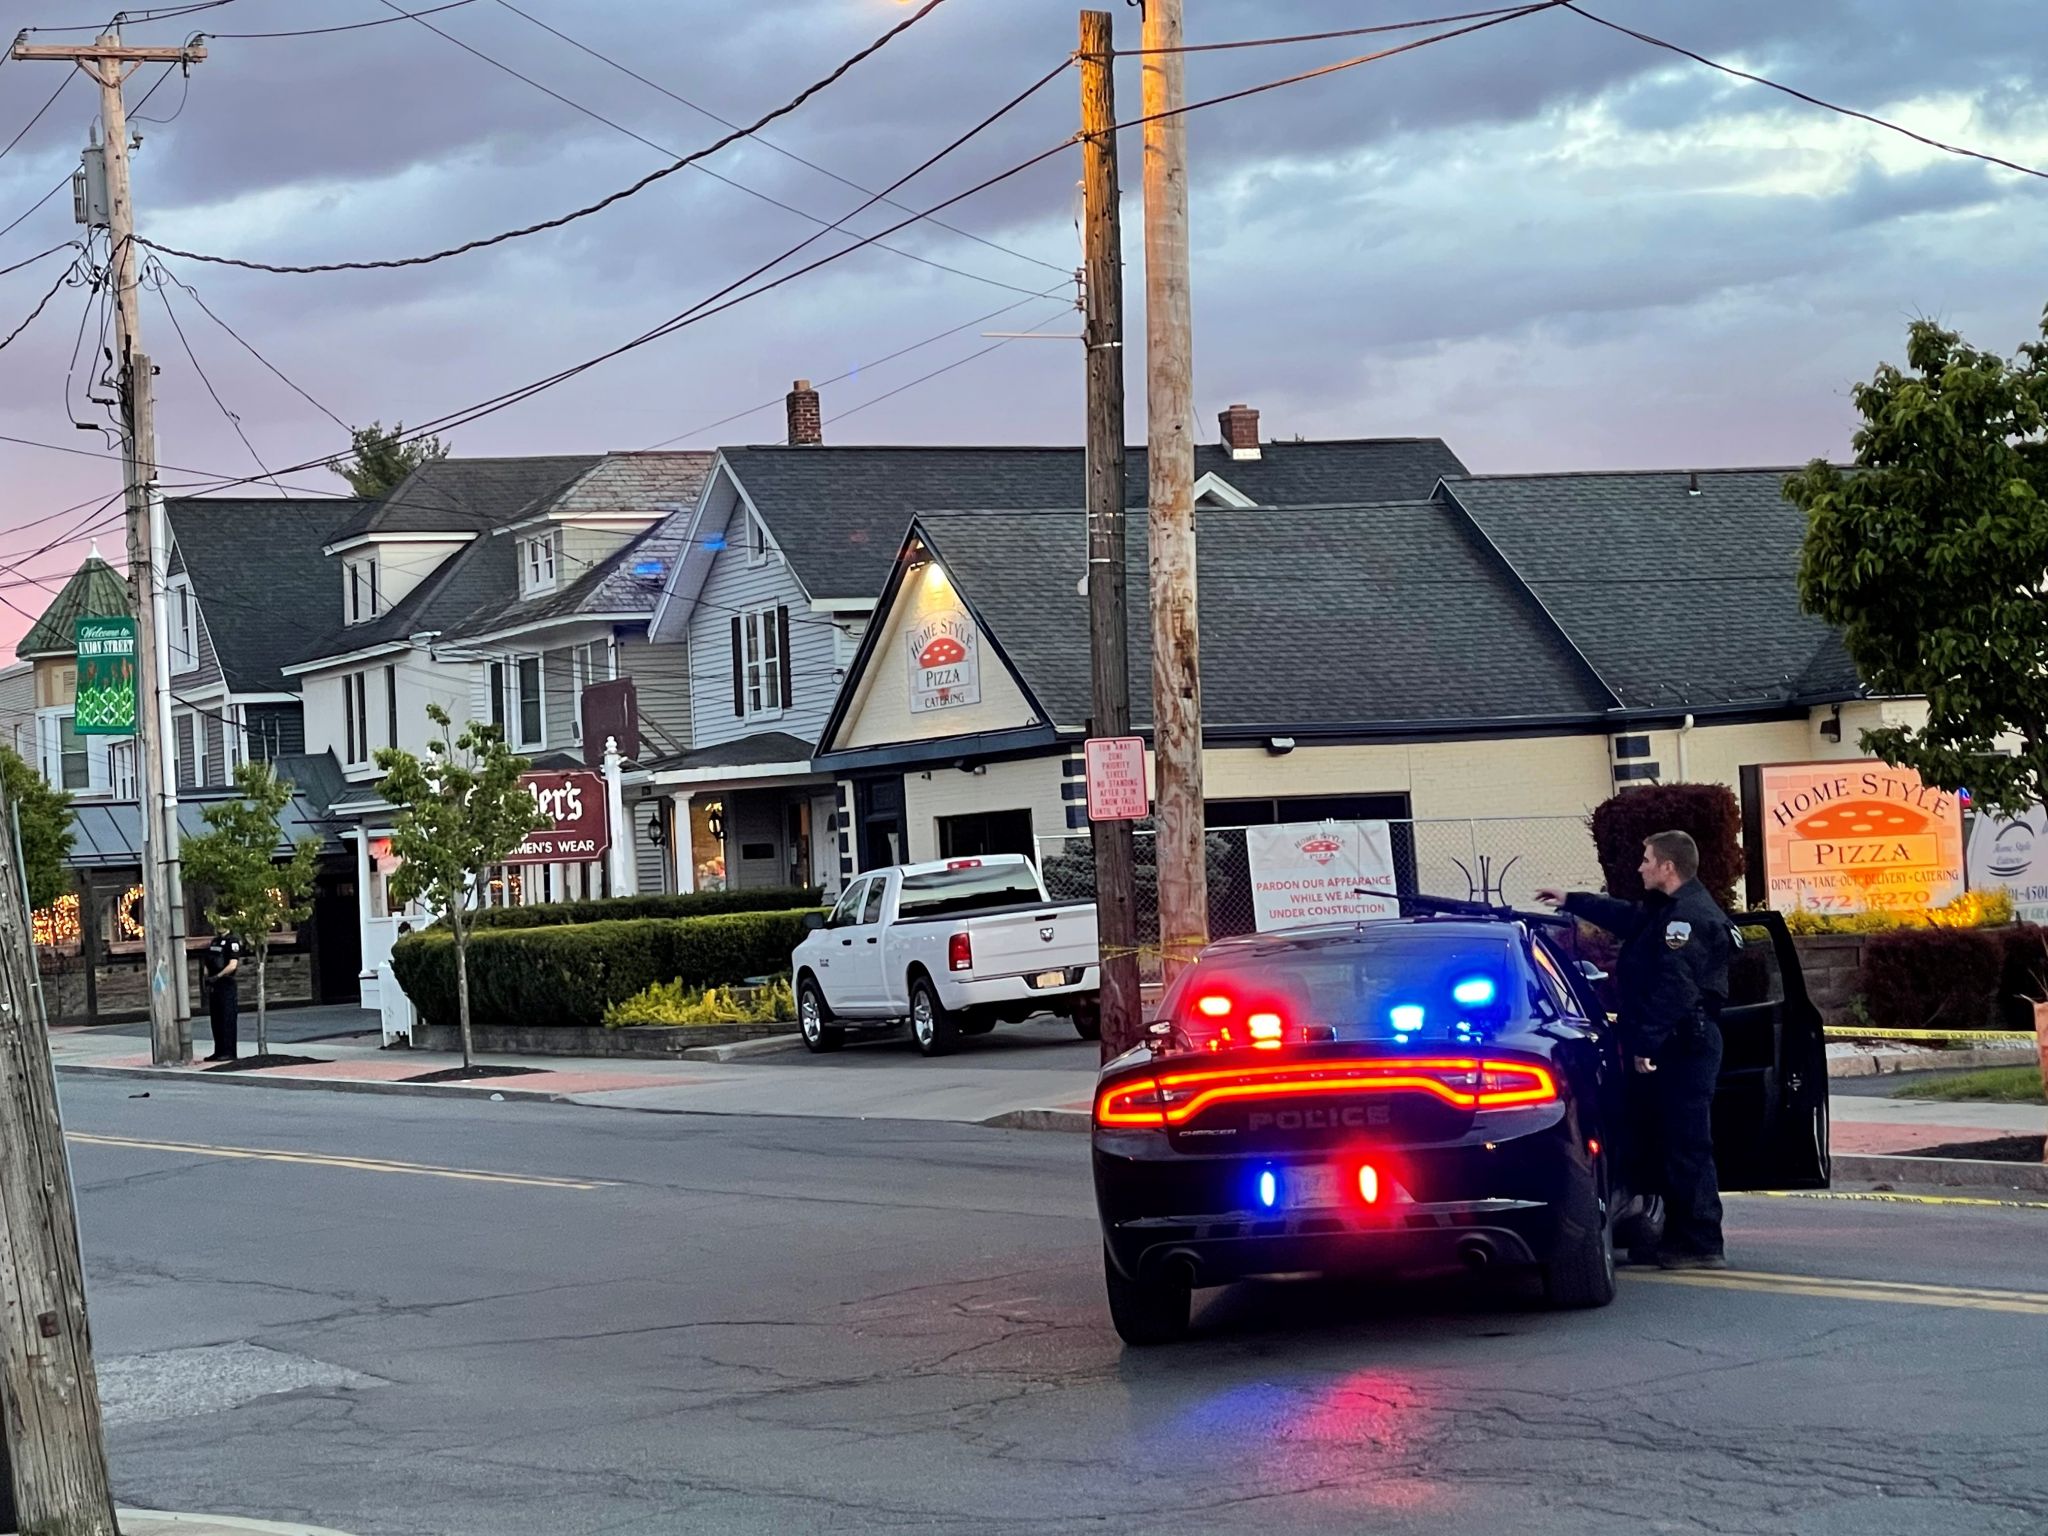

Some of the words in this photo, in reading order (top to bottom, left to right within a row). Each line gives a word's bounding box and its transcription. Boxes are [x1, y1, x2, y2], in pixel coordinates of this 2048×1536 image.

[81, 626, 120, 639] Welcome
[121, 627, 131, 637] to
[911, 622, 938, 660] HOME
[940, 618, 974, 651] STYLE
[78, 641, 102, 655] UNION
[103, 639, 134, 653] STREET
[926, 668, 960, 688] PIZZA
[924, 693, 965, 709] CATERING
[1108, 779, 1138, 788] STANDING
[1100, 788, 1119, 797] AFTER
[1773, 778, 1850, 828] HOME
[1861, 773, 1949, 820] STYLE
[558, 840, 595, 852] WEAR
[1814, 843, 1911, 866] PIZZA
[1256, 880, 1299, 891] PARDON
[1302, 878, 1324, 889] OUR
[1327, 875, 1392, 887] APPEARANCE
[1864, 871, 1907, 885] DELIVERY
[1914, 868, 1959, 881] CATERING
[1290, 893, 1322, 903] WHILE
[1325, 892, 1342, 901] WE
[1344, 891, 1362, 900] ARE
[1269, 908, 1305, 919] UNDER
[1307, 904, 1385, 916] CONSTRUCTION
[1249, 1105, 1390, 1131] POLICE
